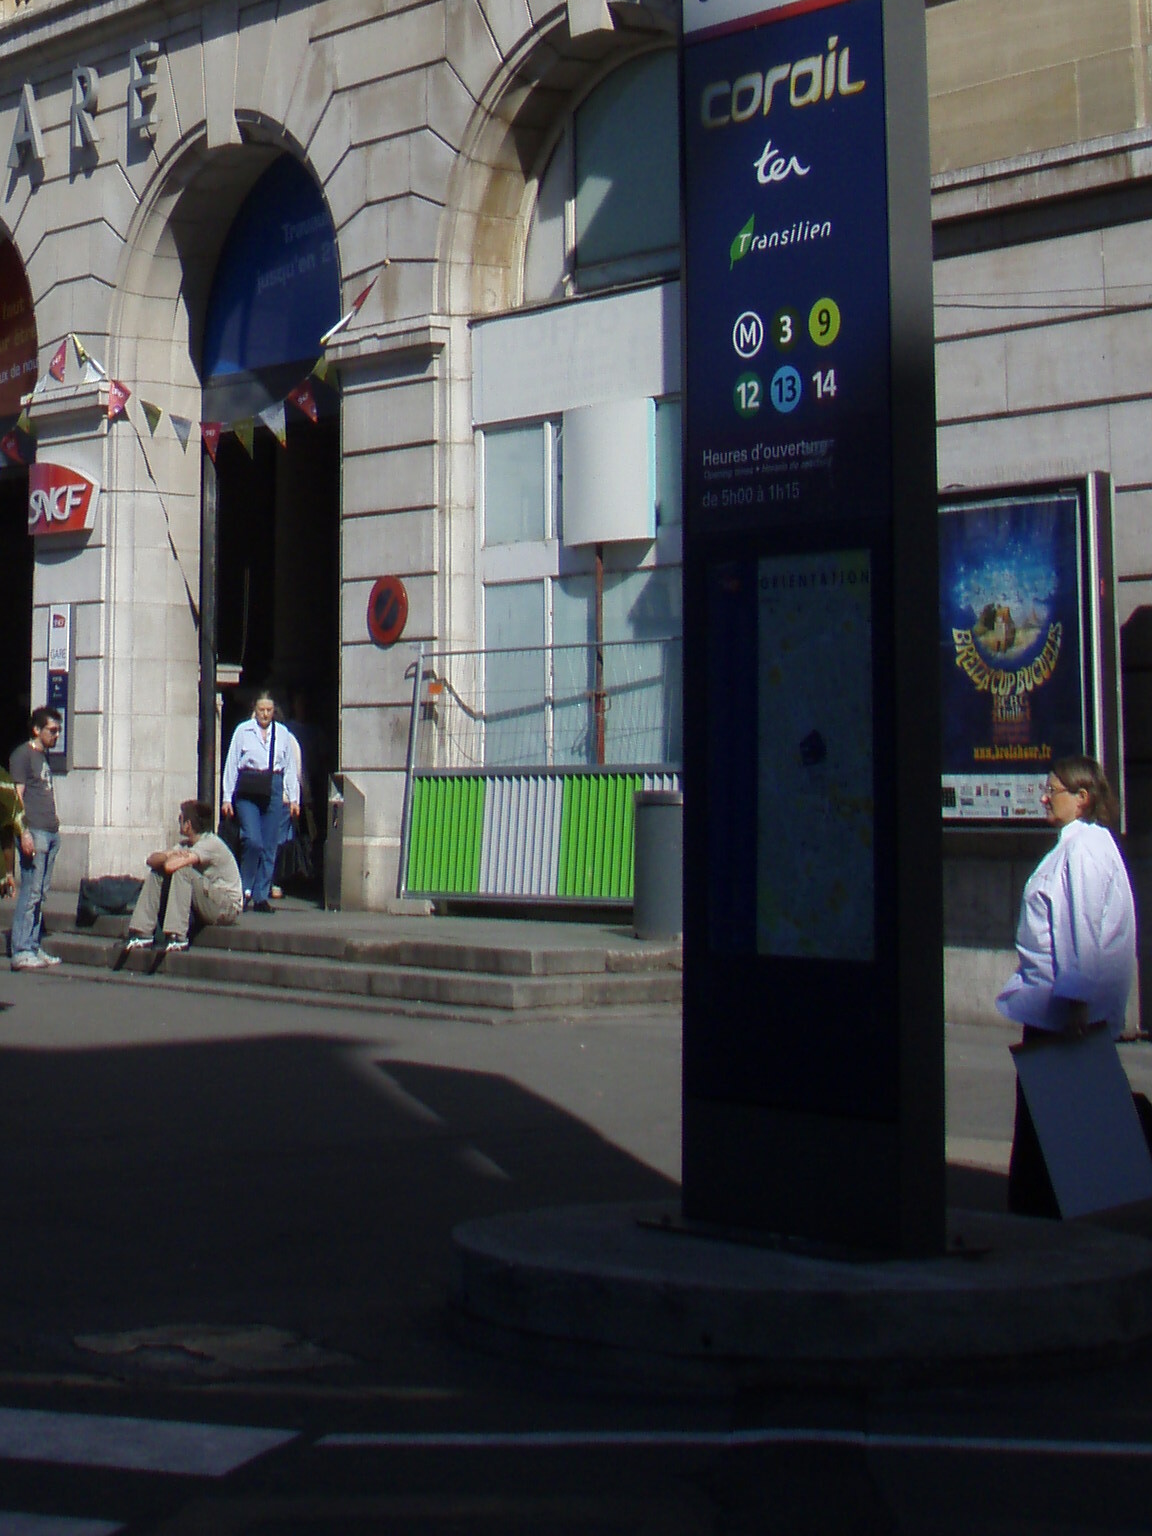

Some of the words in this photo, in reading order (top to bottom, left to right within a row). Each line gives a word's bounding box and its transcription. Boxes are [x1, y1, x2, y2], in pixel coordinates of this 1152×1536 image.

[702, 34, 866, 129] corail
[753, 140, 811, 184] ter
[739, 221, 832, 253] Transilien
[779, 315, 792, 344] 3
[818, 308, 831, 337] 9
[10, 362, 21, 378] de
[736, 380, 760, 410] 12
[774, 375, 797, 404] 13
[812, 368, 837, 400] 14
[702, 448, 748, 467] Heures
[28, 483, 87, 525] SNCF
[702, 491, 718, 507] de
[721, 486, 753, 506] 5h00
[768, 481, 800, 501] 1h15
[760, 568, 870, 591] ORIENTATION
[990, 670, 1017, 696] CUP
